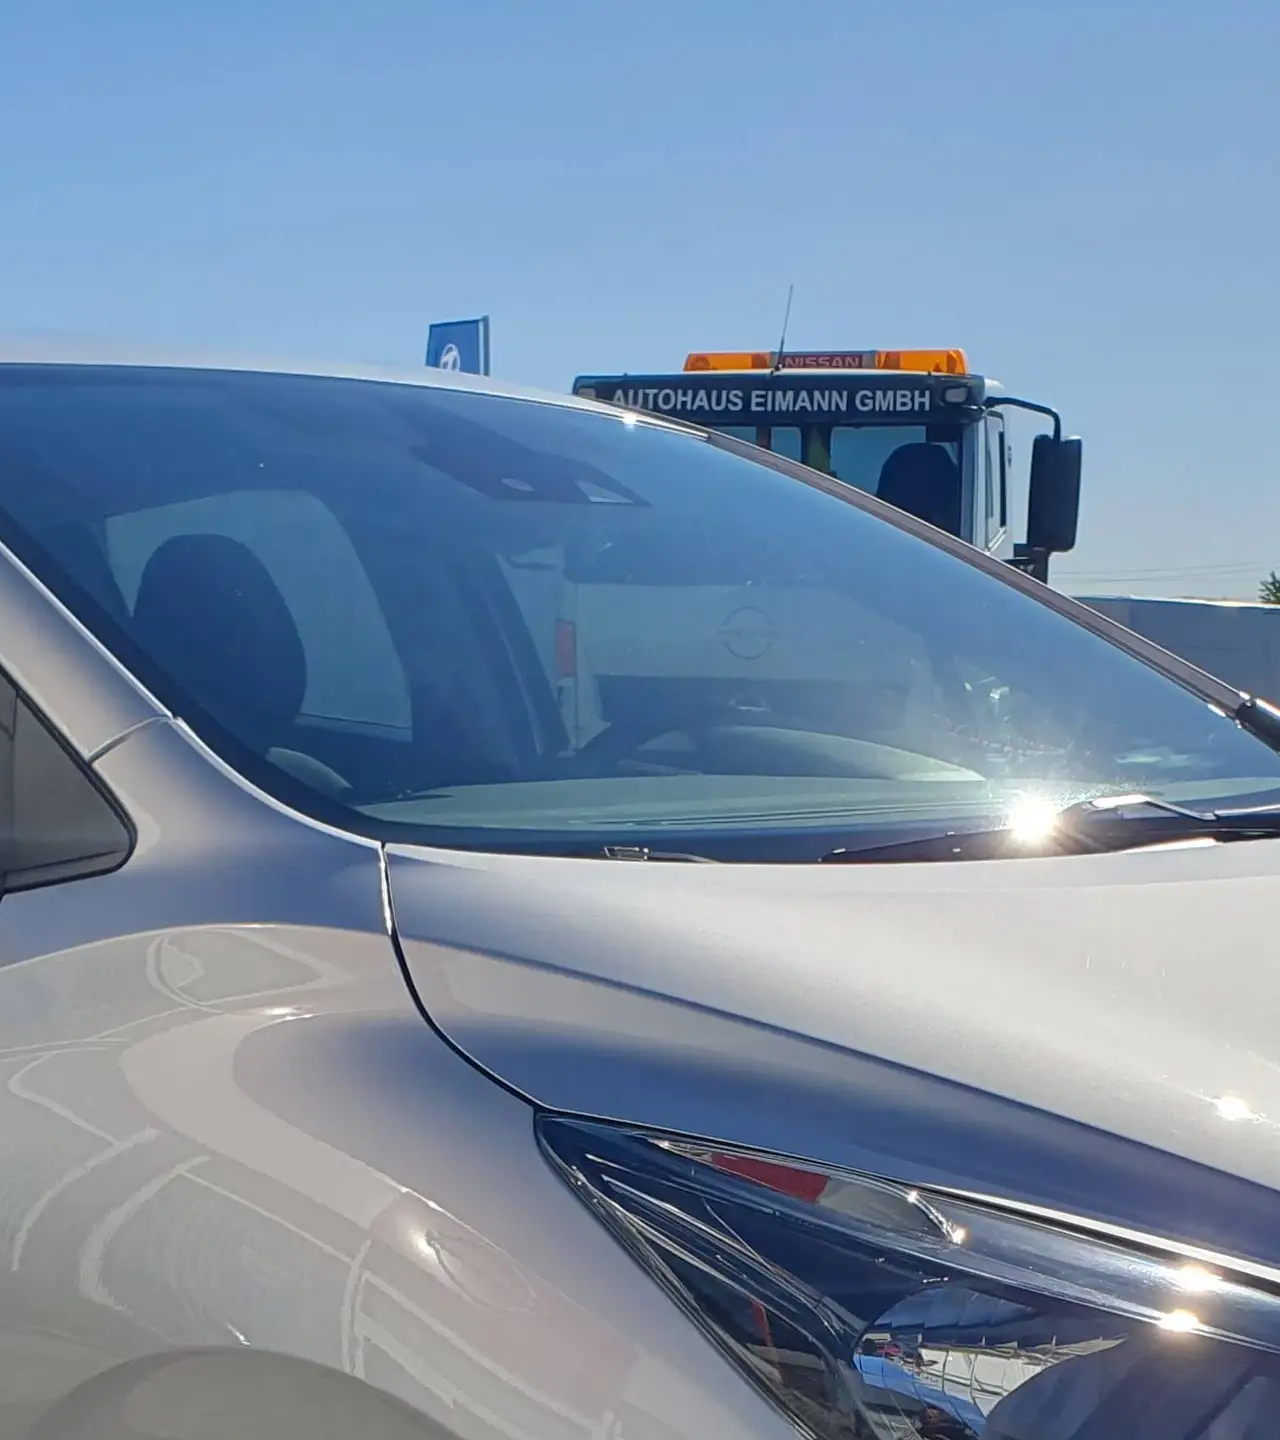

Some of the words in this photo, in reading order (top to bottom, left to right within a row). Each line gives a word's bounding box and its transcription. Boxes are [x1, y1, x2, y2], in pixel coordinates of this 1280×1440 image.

[784, 356, 859, 368] NISSAN
[612, 388, 744, 412] AUTOHAUS
[750, 389, 848, 412] EIMANN
[855, 389, 931, 412] GMBH
